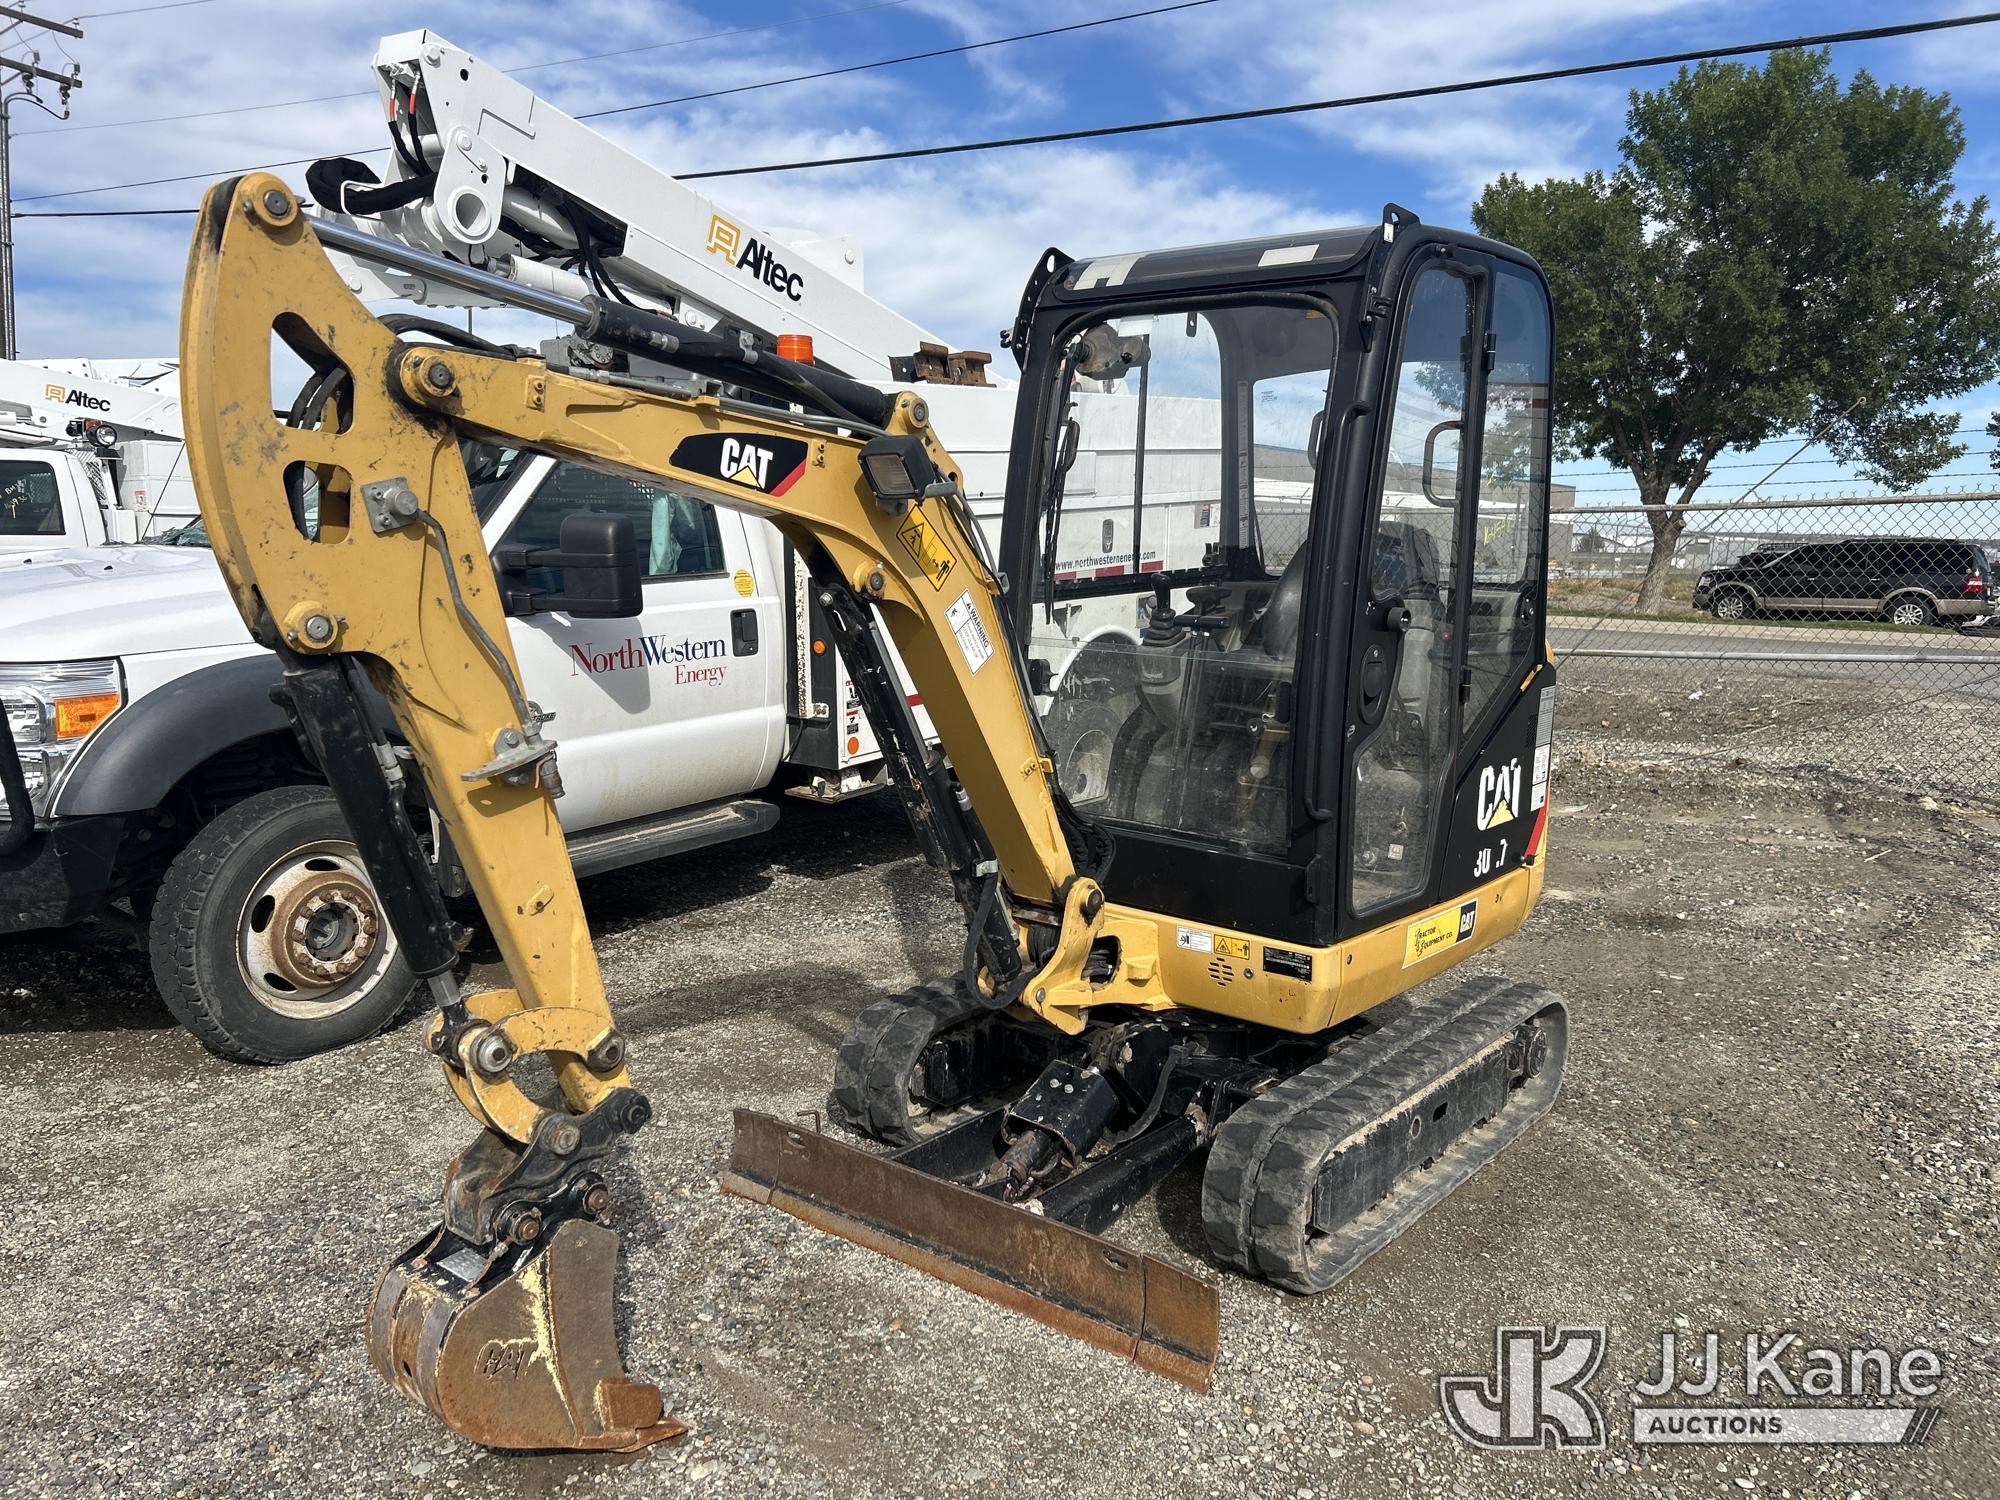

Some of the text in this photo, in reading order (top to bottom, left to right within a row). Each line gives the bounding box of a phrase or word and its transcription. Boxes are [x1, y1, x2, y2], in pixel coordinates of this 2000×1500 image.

[735, 237, 804, 302] Altec
[65, 389, 111, 412] Altec
[720, 437, 774, 489] CAT
[970, 608, 990, 648] WARNING
[568, 634, 728, 677] NorthWestern
[674, 665, 727, 687] Energy
[1477, 757, 1522, 831] CAT
[1460, 910, 1475, 933] CAT
